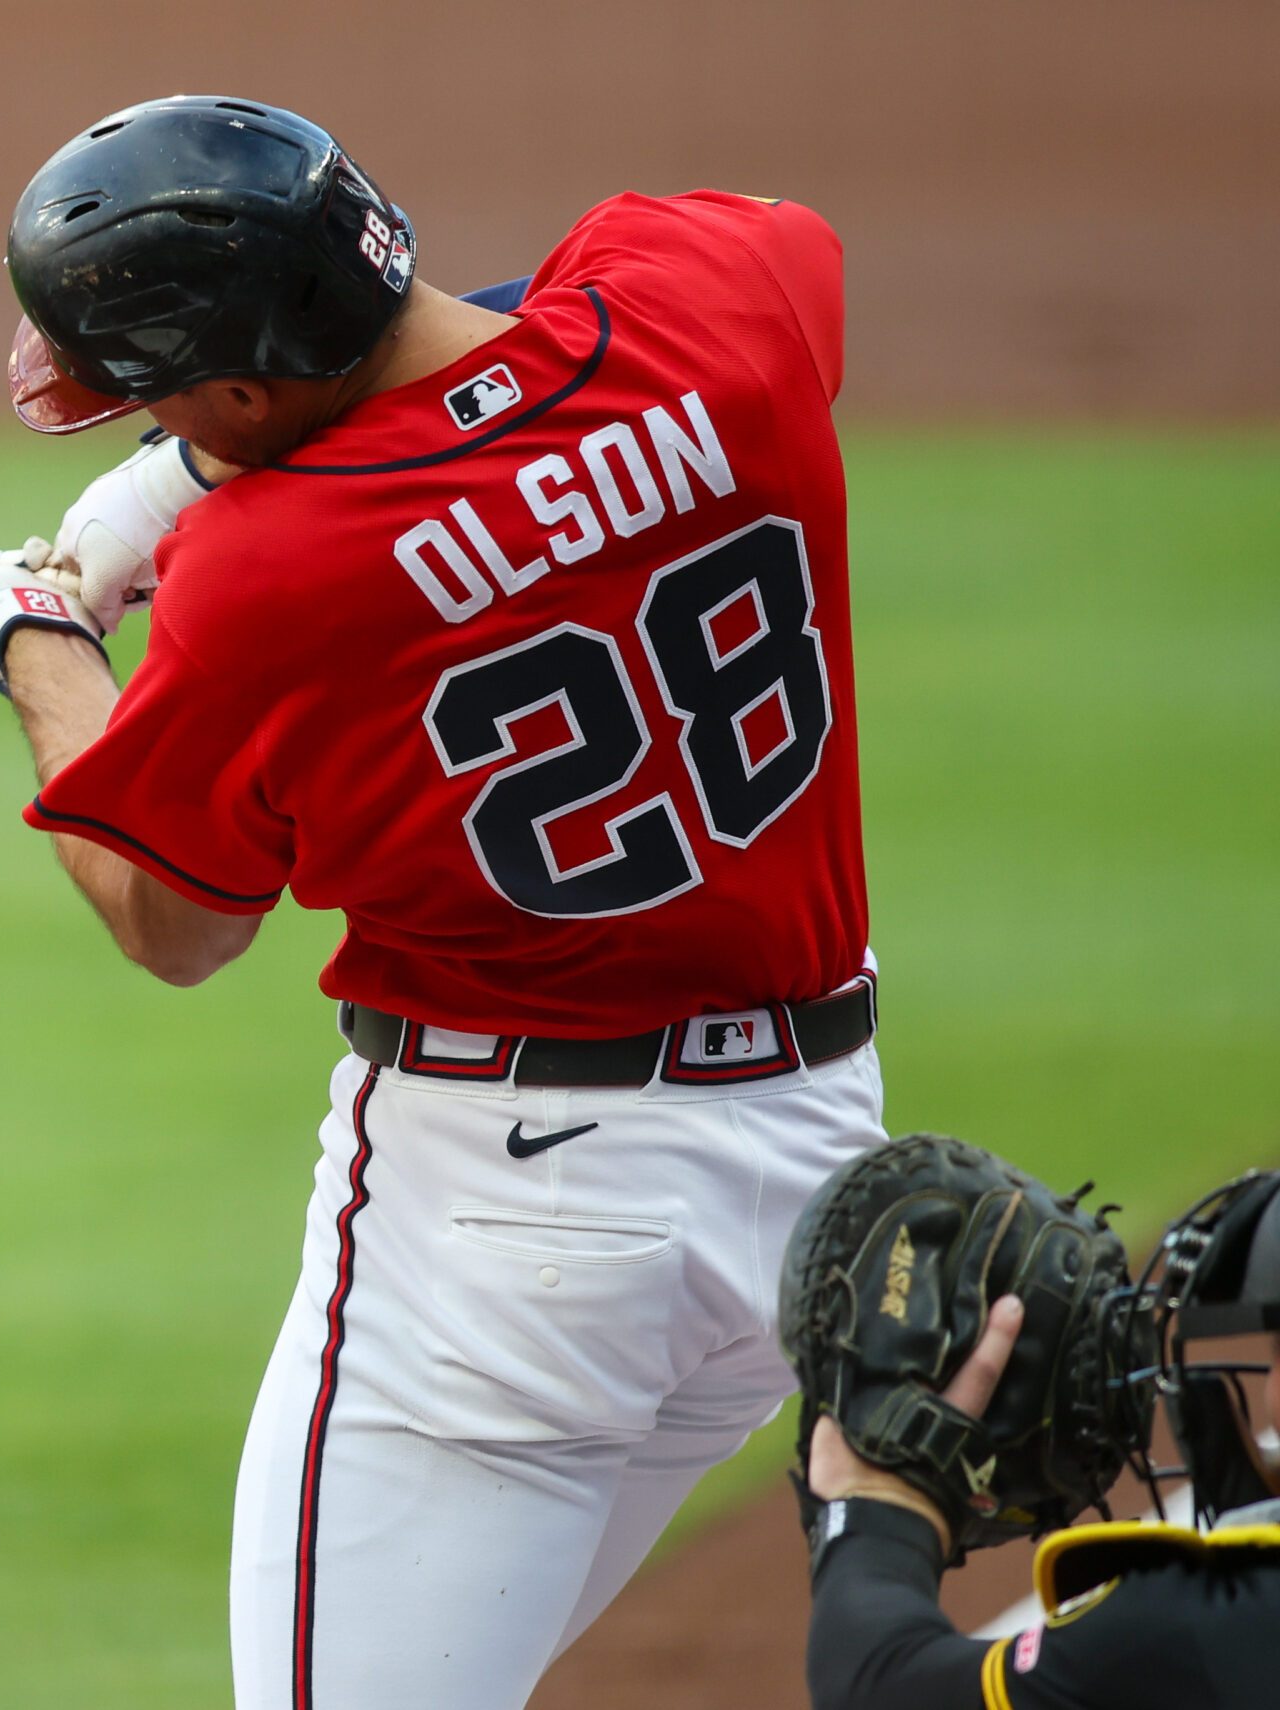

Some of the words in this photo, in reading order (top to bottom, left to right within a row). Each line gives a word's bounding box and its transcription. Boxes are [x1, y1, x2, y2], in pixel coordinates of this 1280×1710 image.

[359, 209, 391, 272] 28
[394, 390, 736, 623] OLSON
[23, 590, 61, 614] 28
[422, 514, 832, 919] 28
